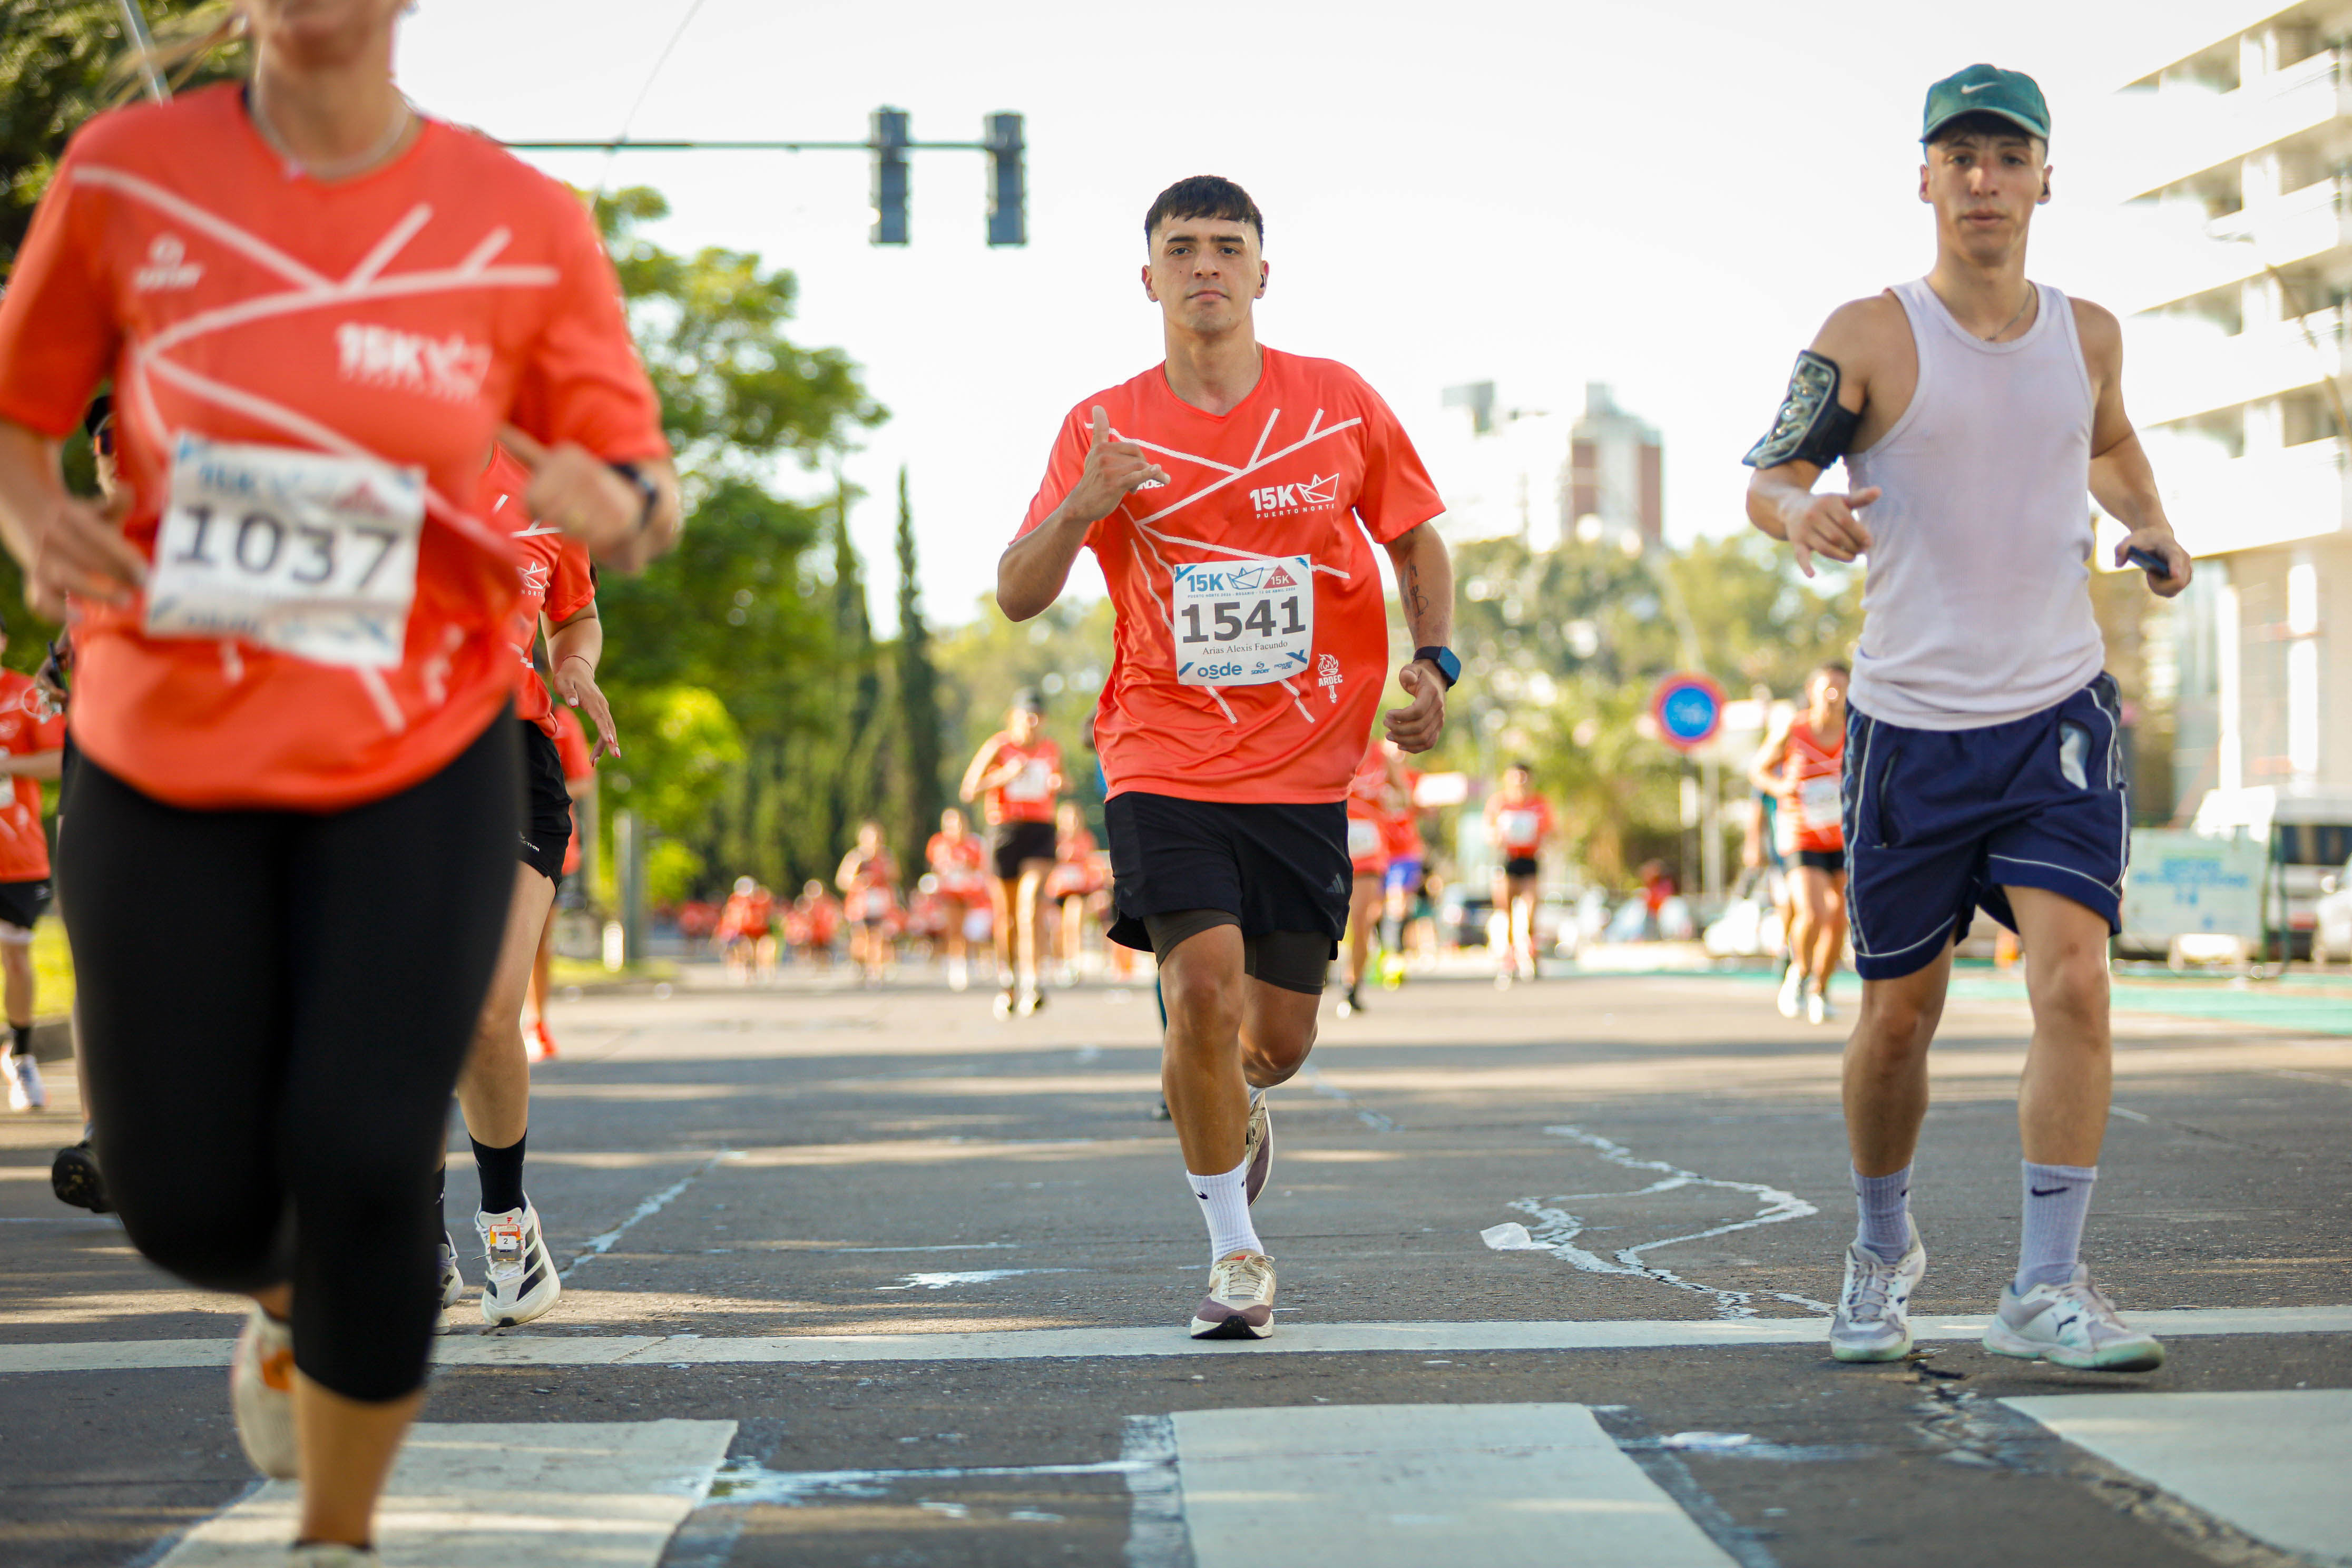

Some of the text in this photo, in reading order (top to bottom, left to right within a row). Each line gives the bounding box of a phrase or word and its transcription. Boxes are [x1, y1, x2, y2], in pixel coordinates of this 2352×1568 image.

[1250, 484, 1298, 511] 15K
[1256, 503, 1335, 519] PUERTO NORTE
[174, 504, 400, 594] 1037
[1187, 573, 1224, 592] 15K
[1270, 574, 1290, 585] 15K
[1181, 595, 1306, 643] 1541
[1202, 640, 1288, 655] Arias Alexis Facundo
[1197, 661, 1243, 678] osde
[1318, 674, 1343, 687] ARDEC
